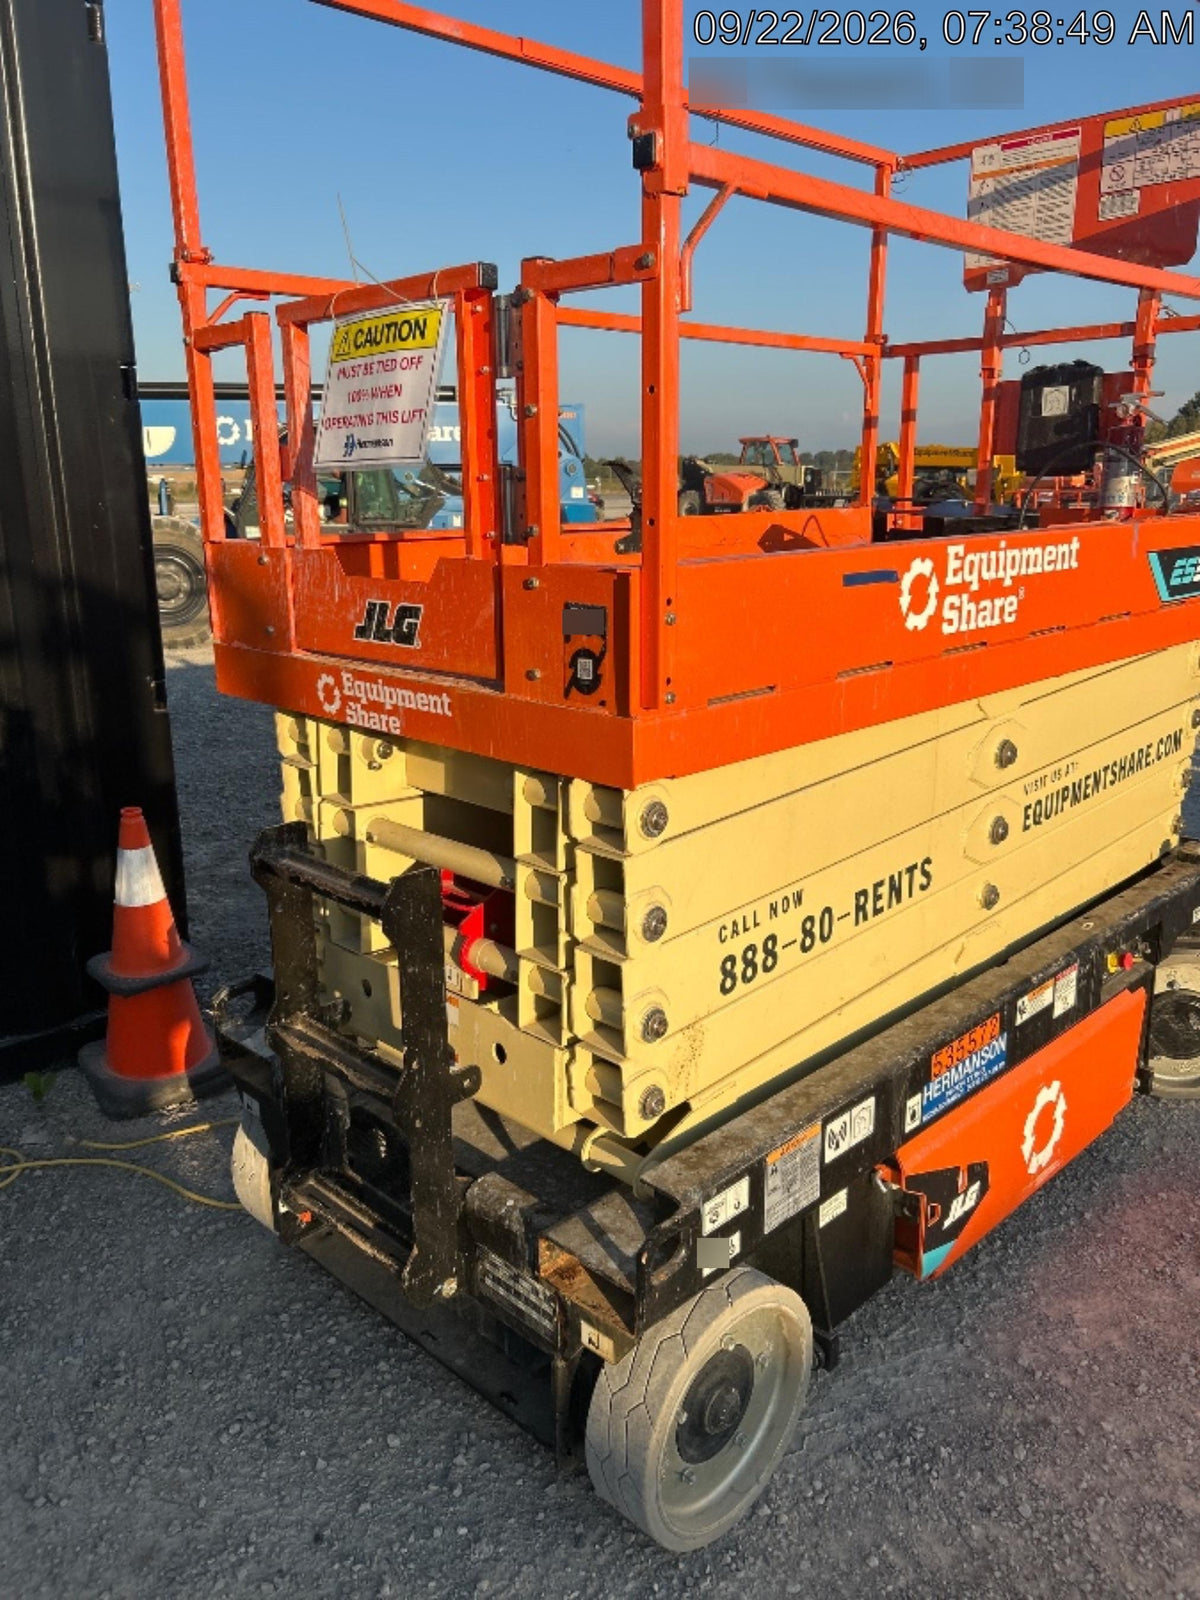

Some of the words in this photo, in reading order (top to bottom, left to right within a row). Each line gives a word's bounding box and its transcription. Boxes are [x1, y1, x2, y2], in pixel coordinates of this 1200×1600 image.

[353, 317, 428, 350] CAUTION
[337, 363, 362, 381] MUST
[363, 361, 375, 376] BE
[376, 358, 398, 374] TIED
[399, 355, 424, 371] OFF
[371, 383, 403, 400] WHEN
[324, 412, 374, 431] OPERATING
[376, 410, 399, 426] THIS
[401, 408, 425, 424] LIFT
[944, 536, 1080, 592] Equipment
[353, 599, 424, 649] JLG
[340, 670, 453, 717] Equipment
[345, 701, 401, 735] Share
[1022, 728, 1183, 832] EQUIPMENTSHARE.COM
[1023, 772, 1048, 796] VISIT
[1051, 769, 1062, 783] US
[718, 909, 761, 944] CALL
[769, 888, 804, 920] NOW
[719, 856, 933, 996] 888-80-RENTS
[922, 1031, 1008, 1106] HERMANSON
[942, 1180, 981, 1231] JLG
